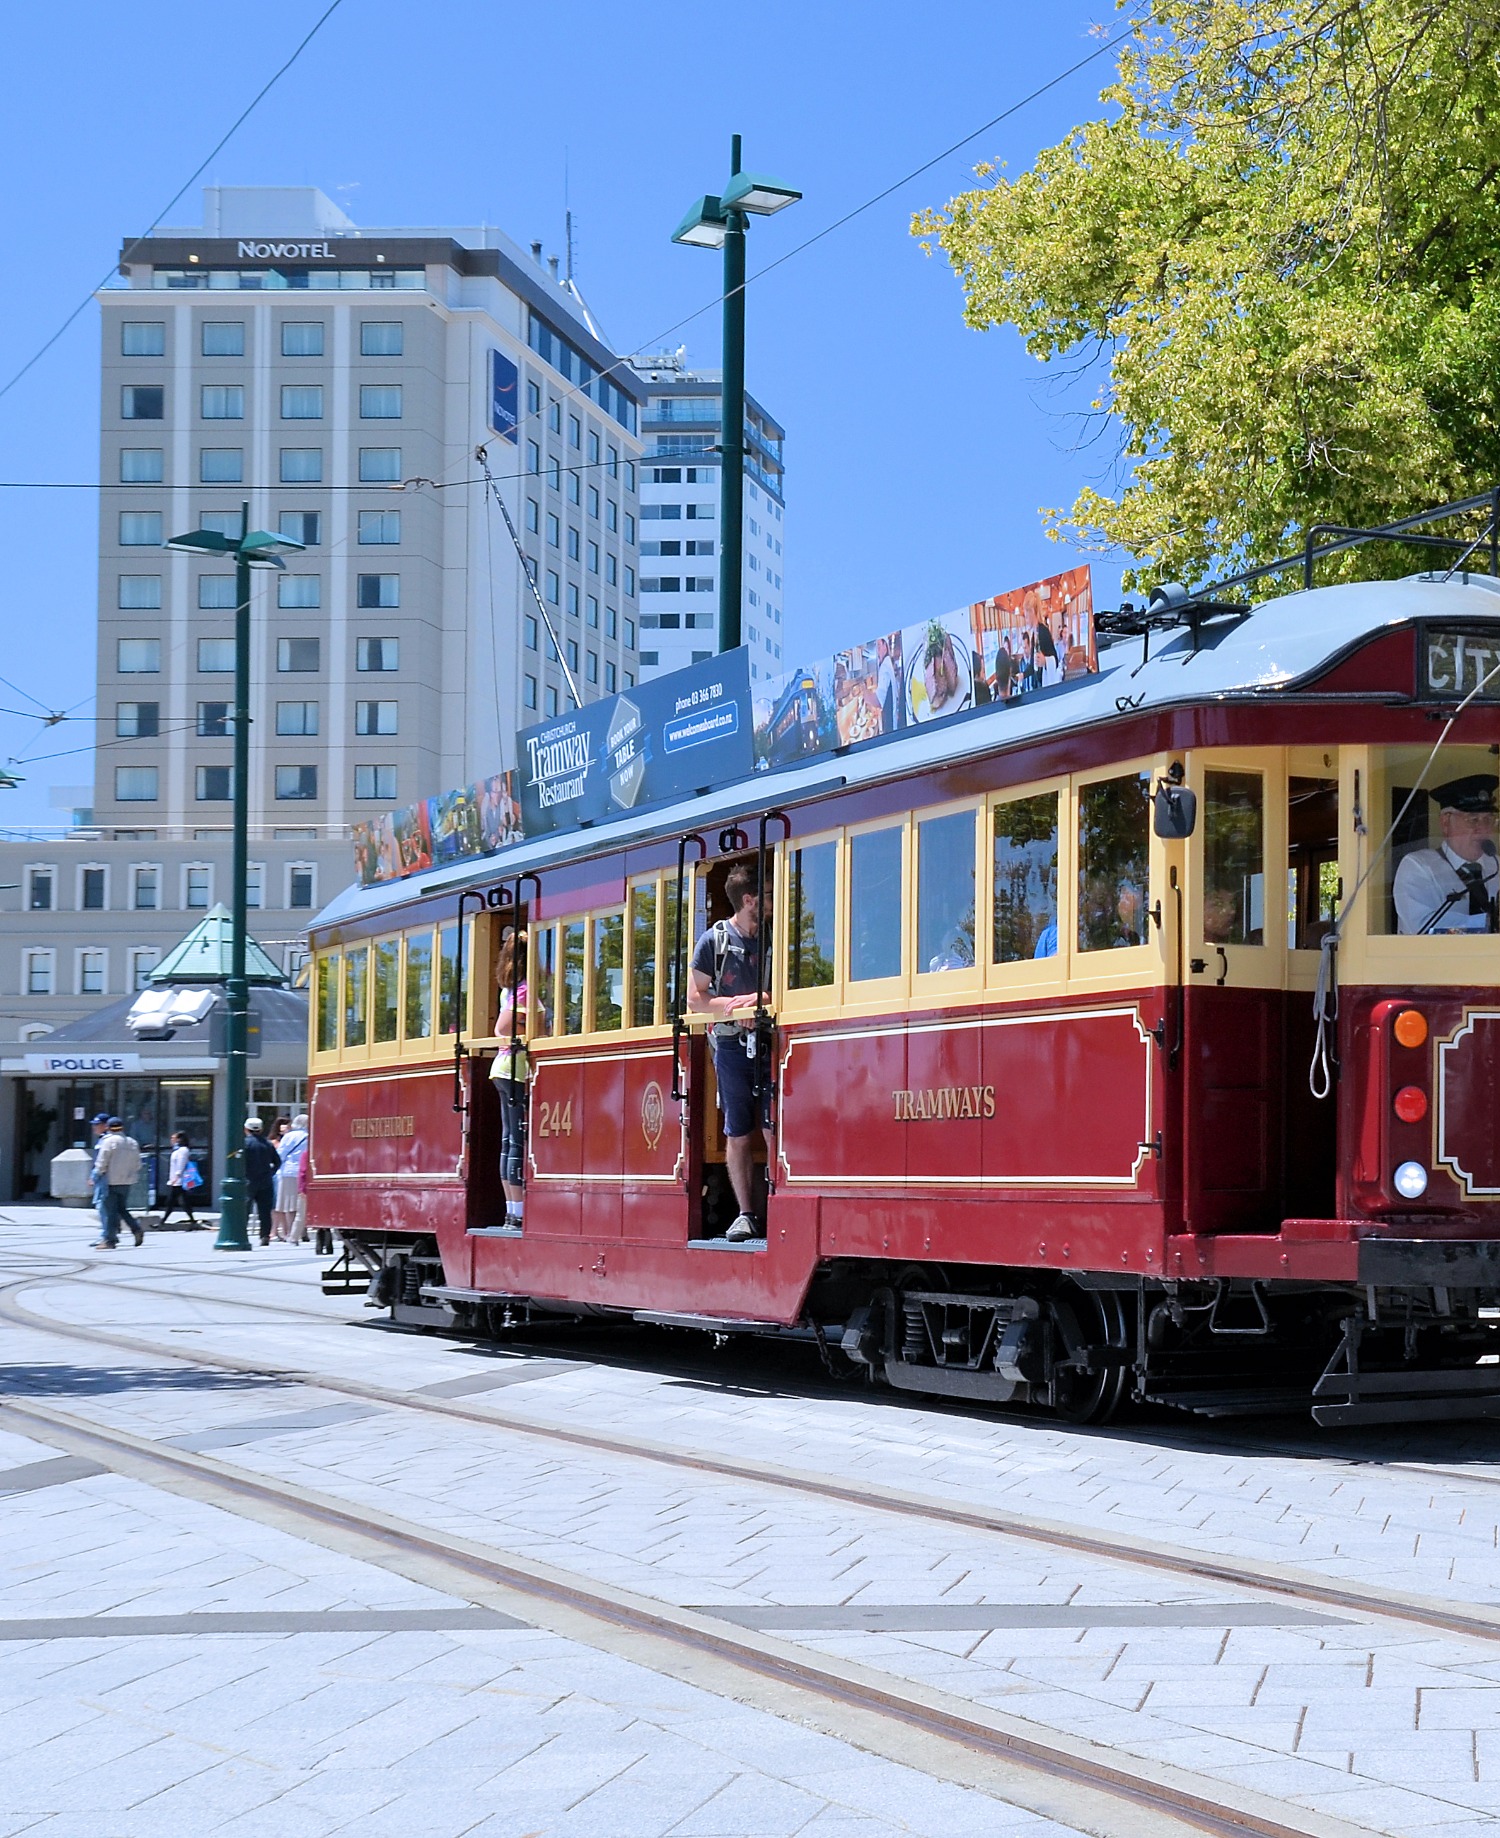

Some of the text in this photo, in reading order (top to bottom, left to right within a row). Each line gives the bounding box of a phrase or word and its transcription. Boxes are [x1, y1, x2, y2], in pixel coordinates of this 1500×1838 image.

[237, 241, 336, 258] NOVOTEL
[675, 683, 723, 714] phone 03 366 7830
[540, 721, 576, 744] CHRISTCHURCH
[610, 717, 637, 748] BOOK YOUR
[668, 713, 733, 742] www.welcomeaboard.co.nz
[527, 731, 591, 781] Tramway
[614, 739, 635, 769] TABLE
[538, 772, 585, 808] Restaurant
[620, 764, 634, 786] NOW
[50, 1059, 124, 1070] POLICE
[892, 1085, 995, 1120] TRAMWAYS
[350, 1115, 414, 1138] CHRISTCHURCH
[539, 1101, 572, 1137] 244
